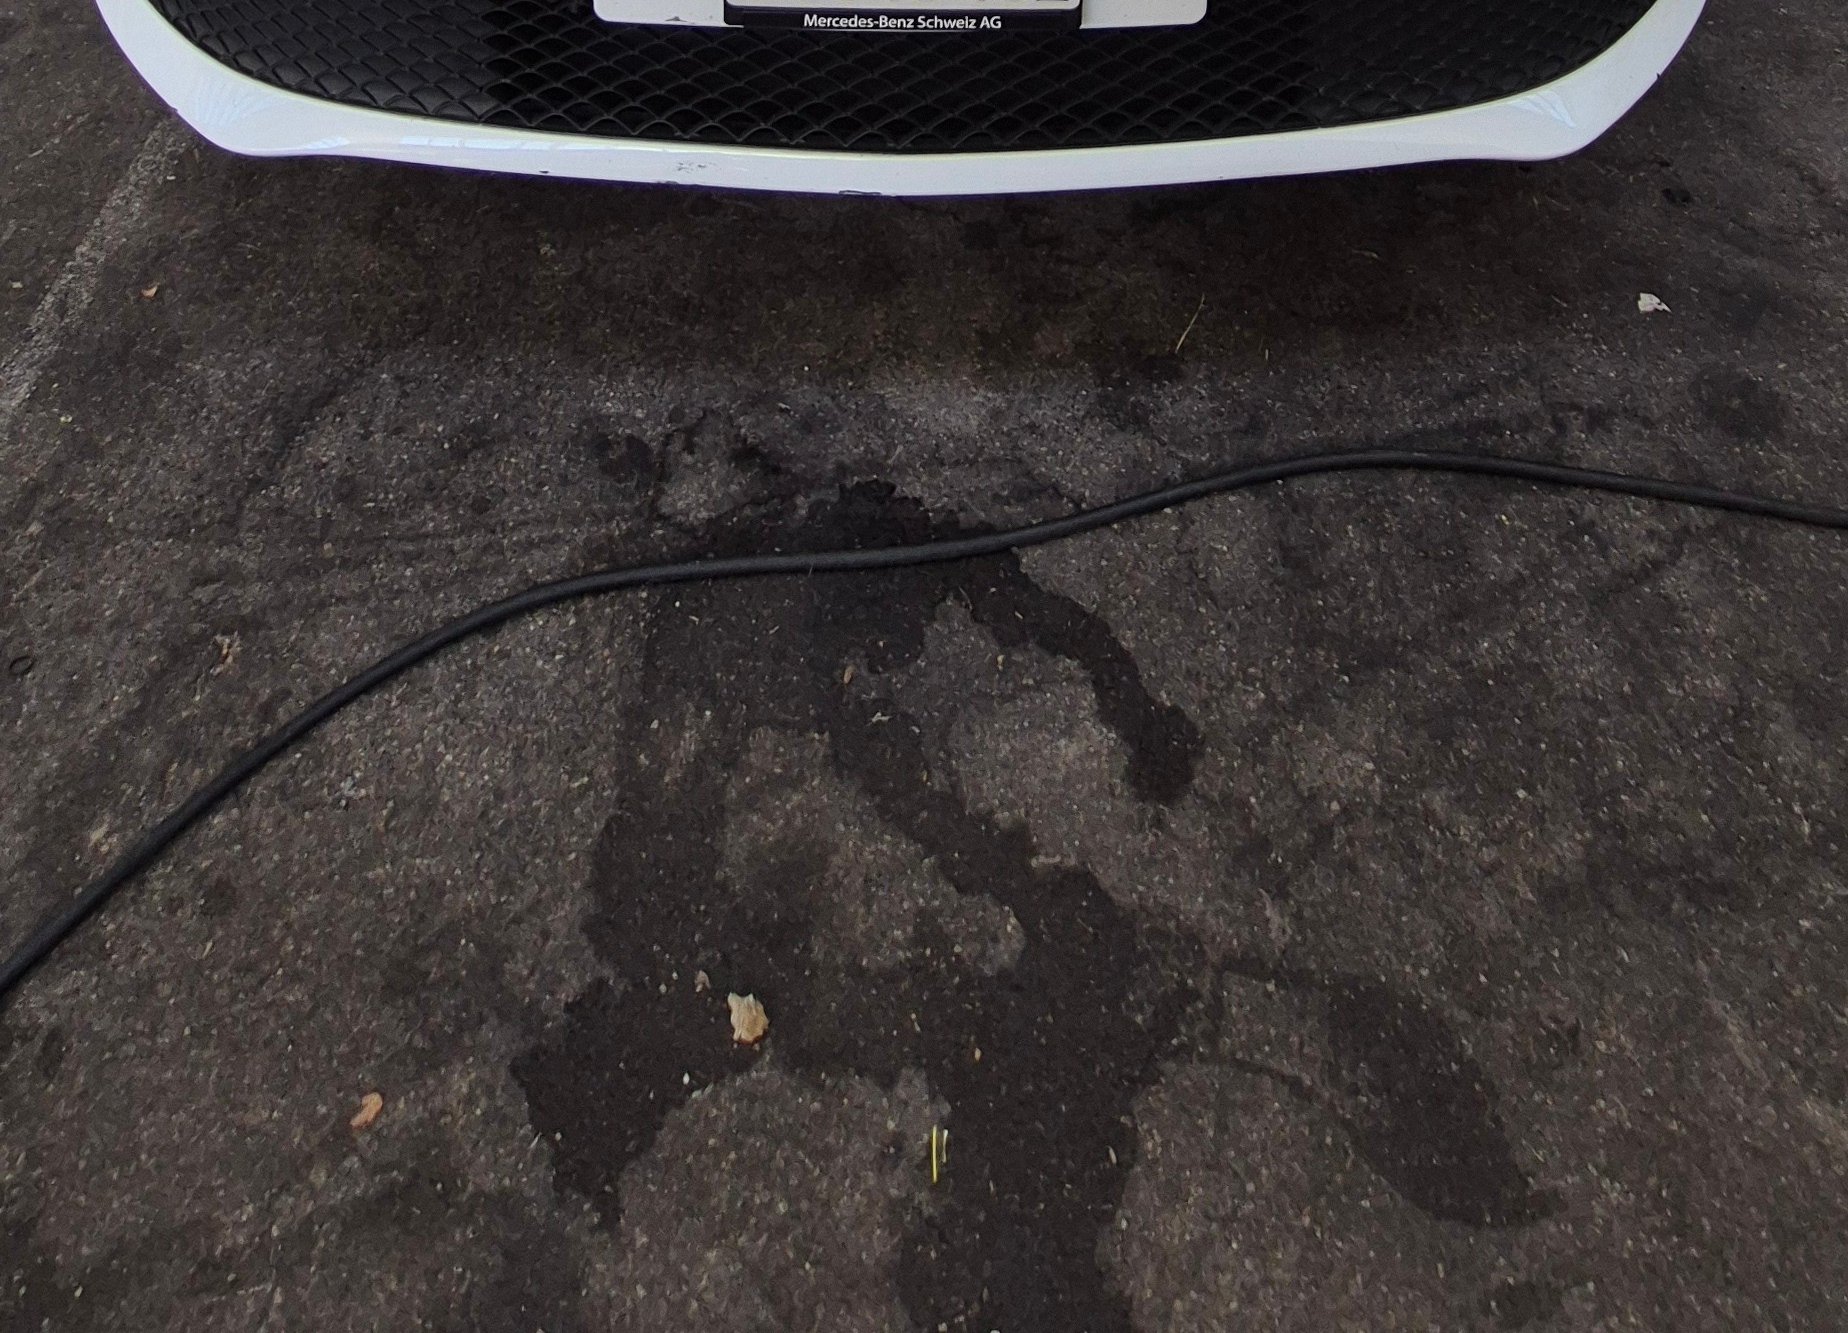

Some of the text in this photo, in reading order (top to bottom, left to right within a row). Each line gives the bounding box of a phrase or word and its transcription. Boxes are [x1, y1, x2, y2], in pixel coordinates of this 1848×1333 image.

[803, 14, 1002, 30] Mercedes-Benz Schweiz AG
